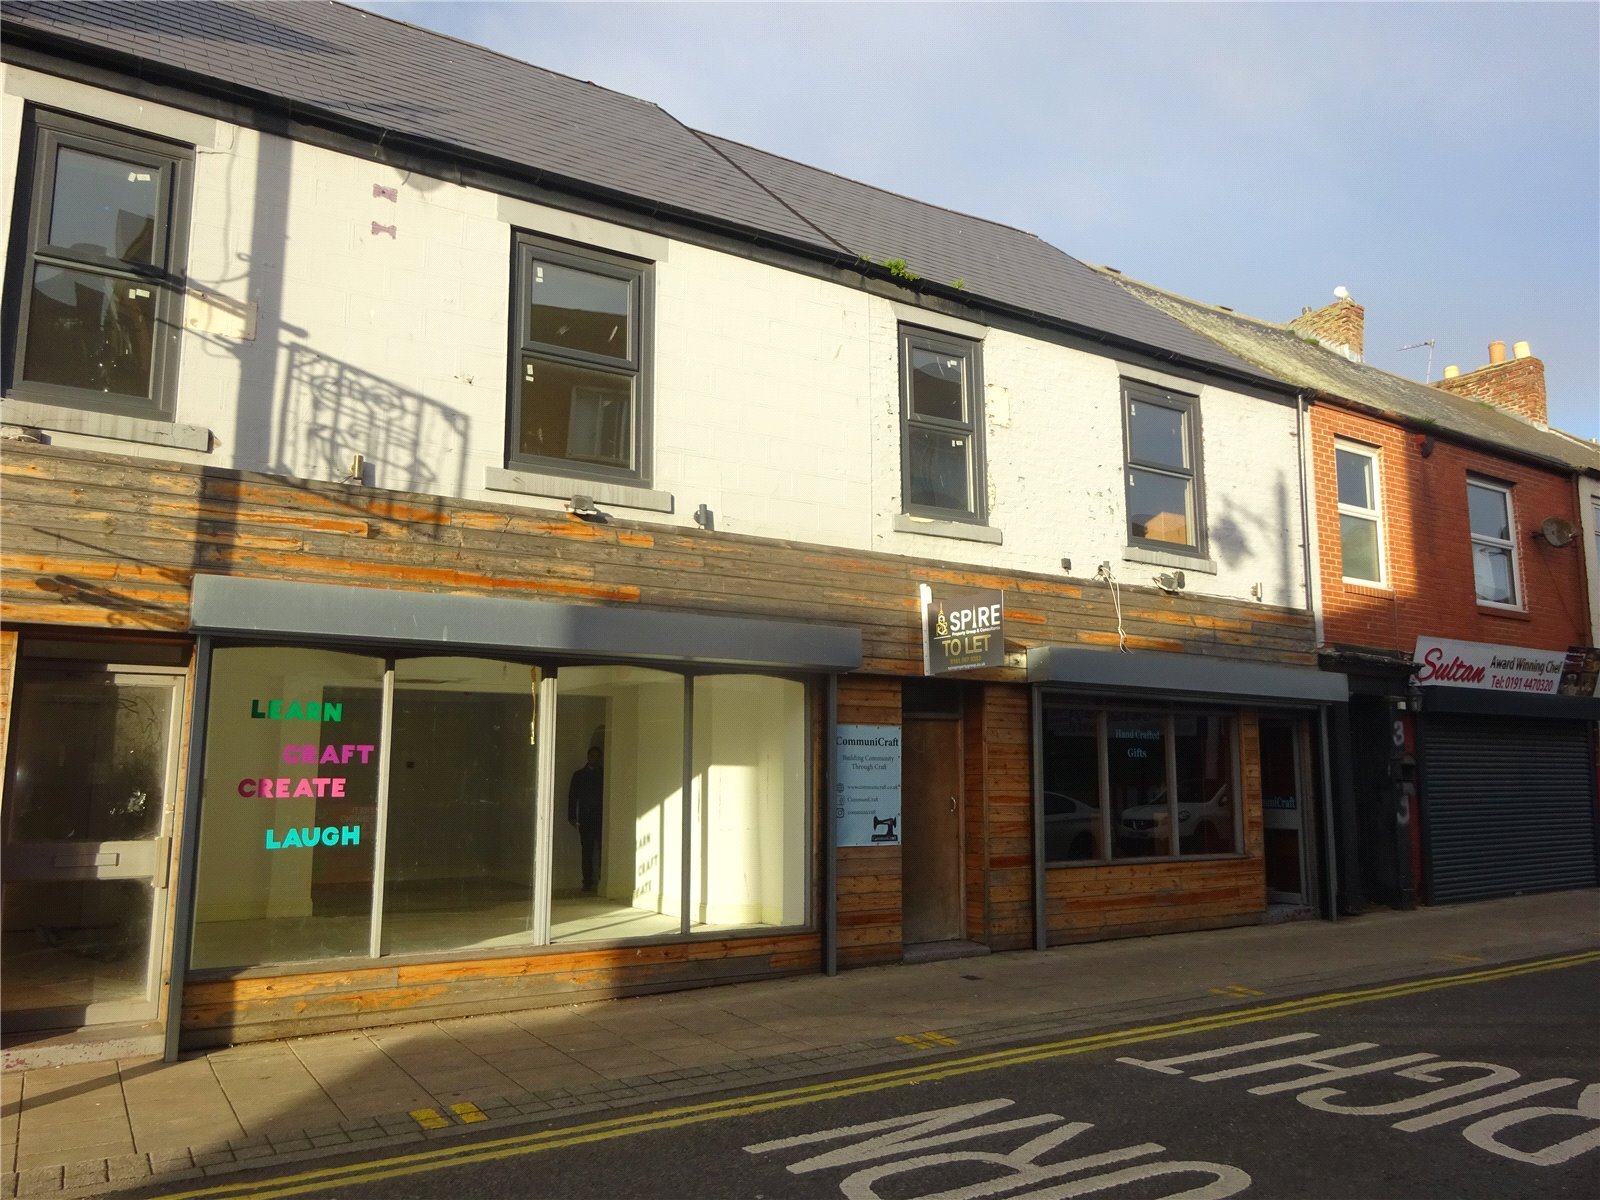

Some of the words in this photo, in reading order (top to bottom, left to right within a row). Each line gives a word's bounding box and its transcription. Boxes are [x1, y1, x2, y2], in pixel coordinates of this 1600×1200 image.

[950, 604, 1001, 631] SPIRE
[942, 638, 962, 657] TO
[964, 634, 991, 654] LET
[1414, 647, 1486, 684] Sultan
[1490, 655, 1515, 670] Award
[1516, 657, 1544, 676] Winning
[1545, 660, 1563, 674] Chef
[1491, 675, 1504, 689] Tel:
[1504, 676, 1523, 691] 0191
[1523, 677, 1553, 692] 4470320
[251, 699, 343, 722] LEARN
[835, 736, 899, 747] CommuniCraft
[1127, 746, 1148, 758] Gifts
[282, 744, 375, 765] CRAFT
[842, 754, 864, 762] Building
[864, 754, 894, 762] Community
[852, 763, 873, 771] Through
[237, 778, 347, 798] CREATE
[265, 825, 361, 849] LAUGH
